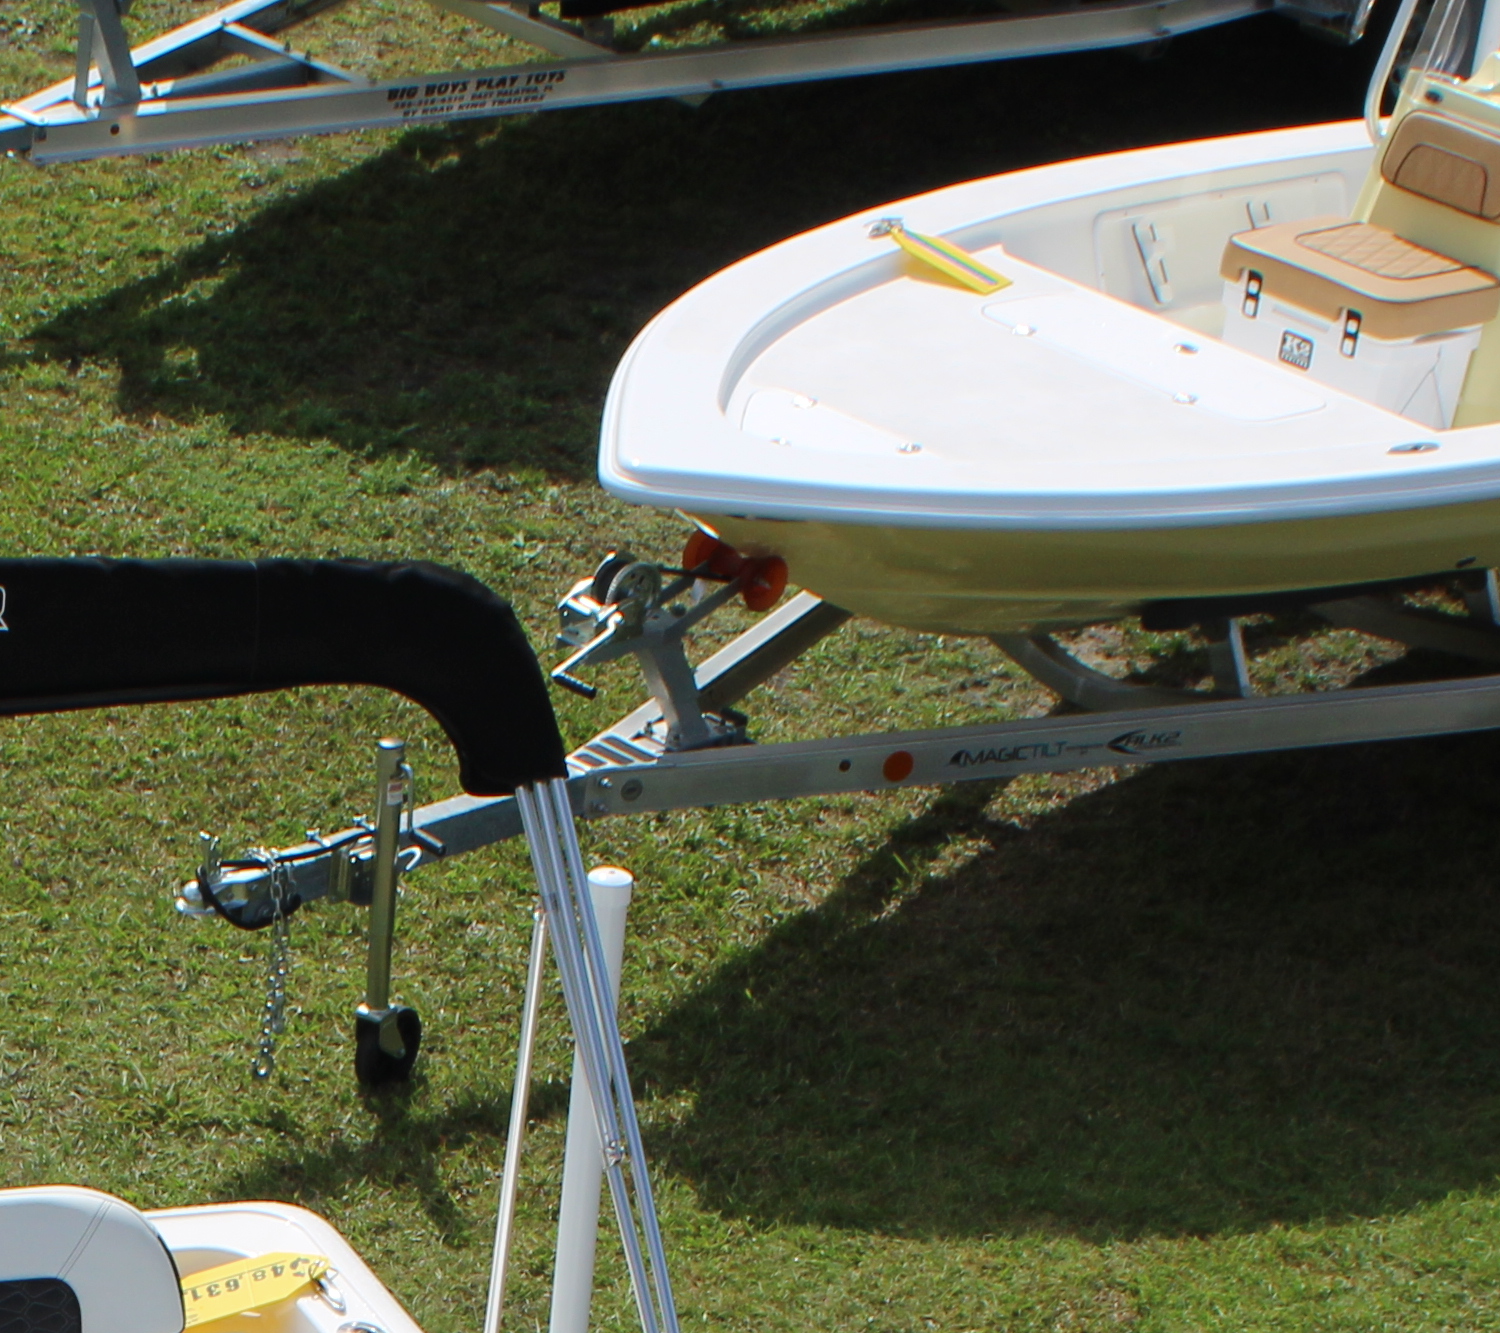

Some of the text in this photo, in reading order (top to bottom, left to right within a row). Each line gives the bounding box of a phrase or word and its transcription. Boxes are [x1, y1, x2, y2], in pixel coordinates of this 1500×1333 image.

[387, 69, 567, 101] BIG BOYS PLAY TOYS
